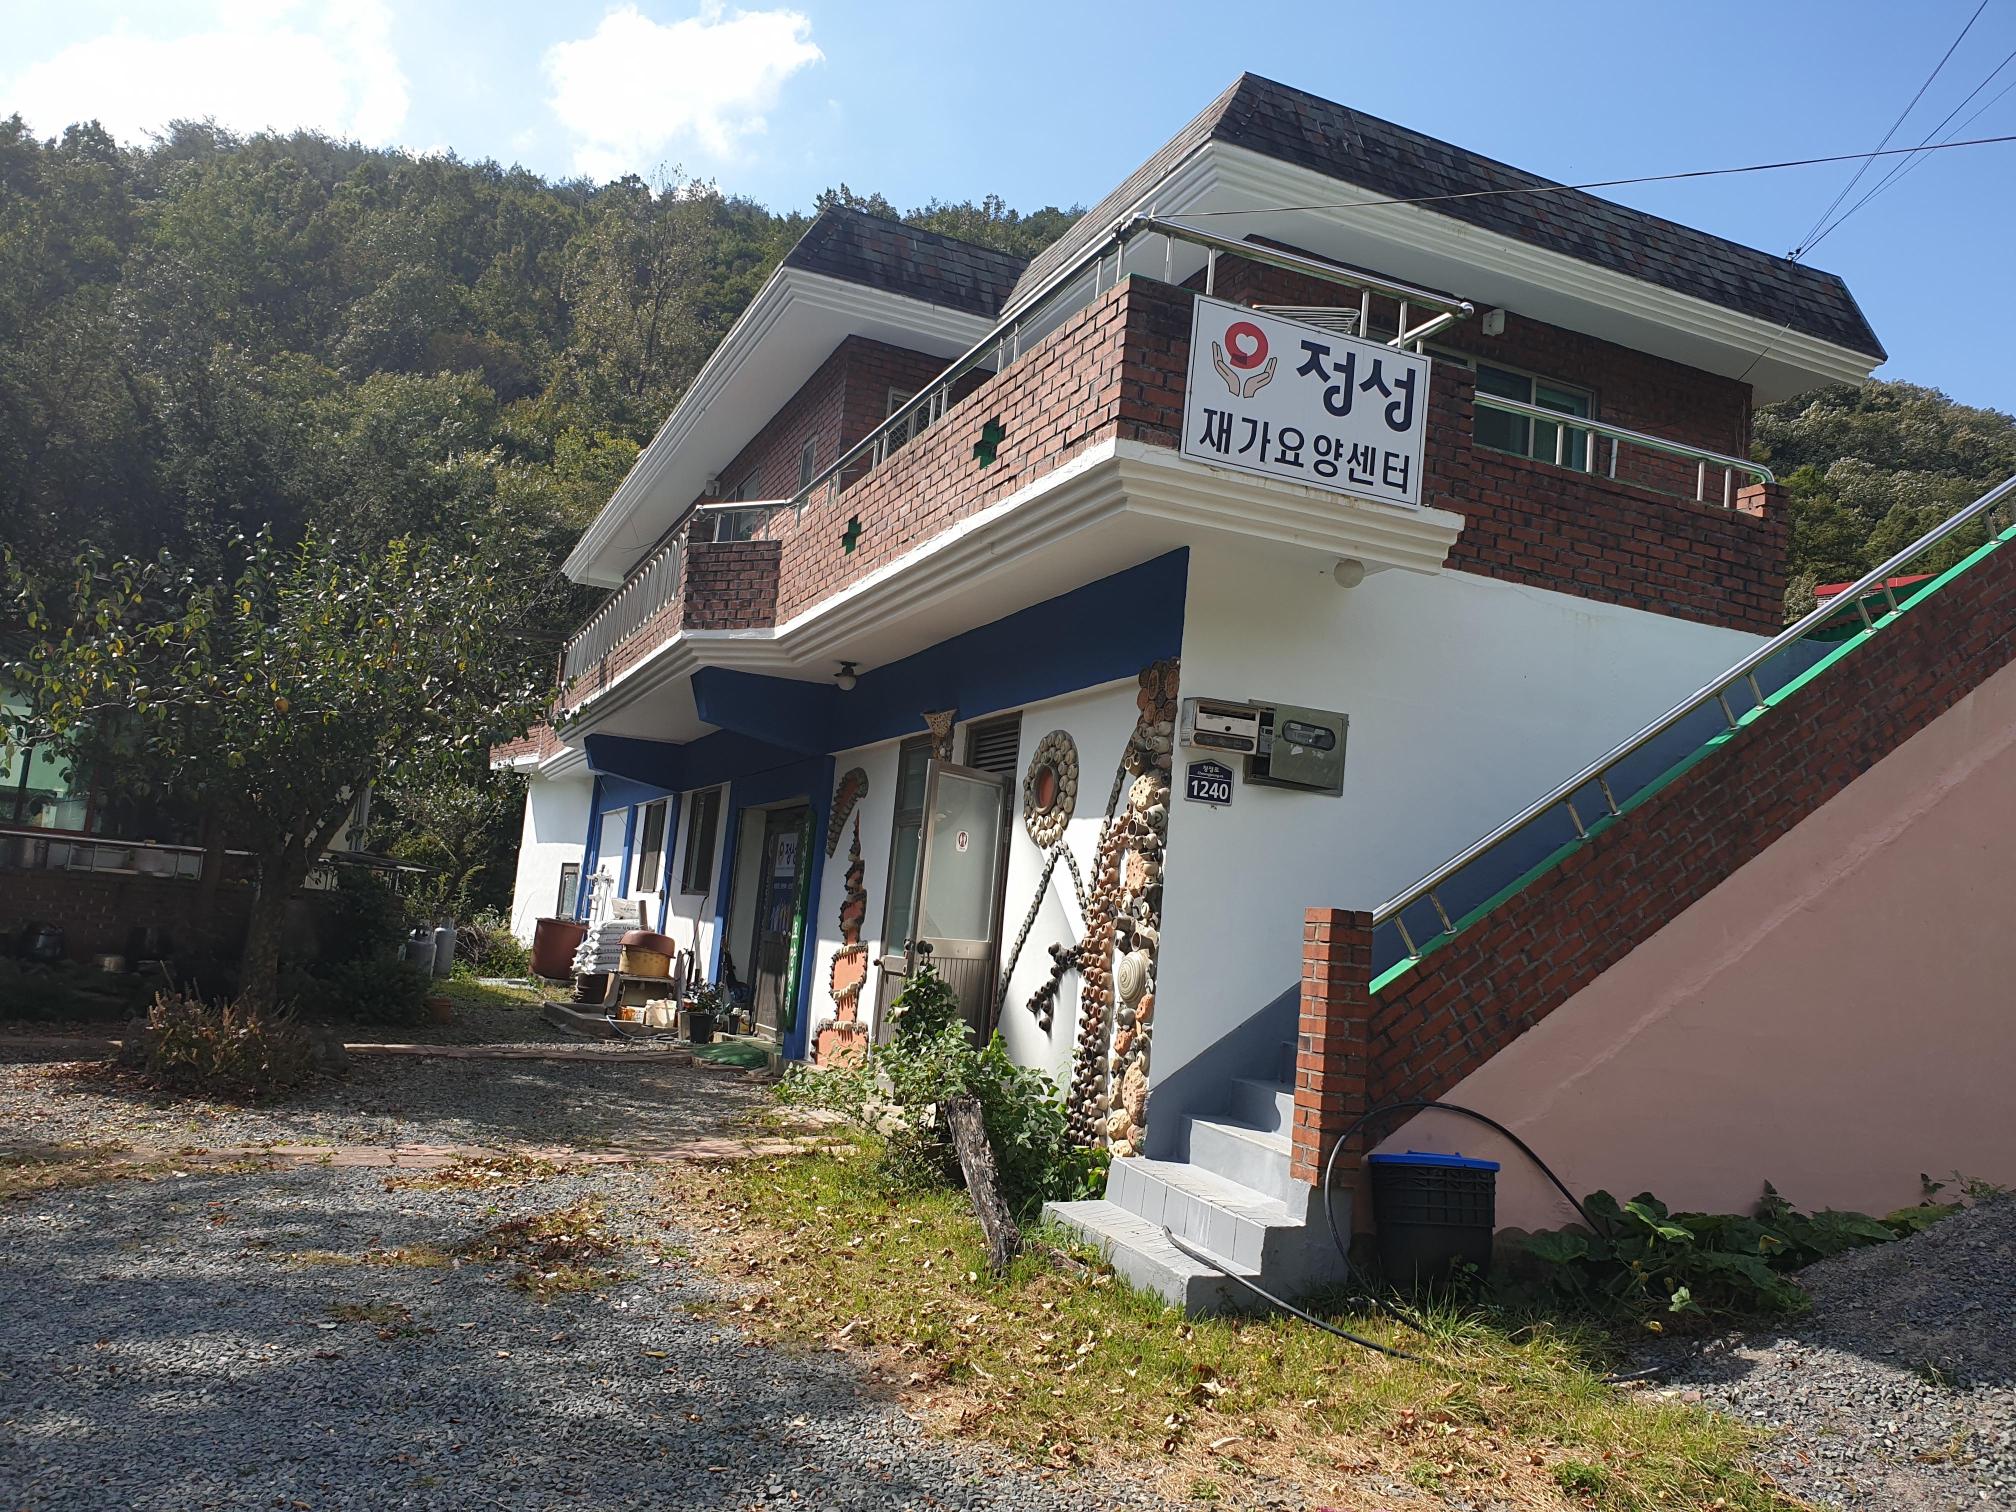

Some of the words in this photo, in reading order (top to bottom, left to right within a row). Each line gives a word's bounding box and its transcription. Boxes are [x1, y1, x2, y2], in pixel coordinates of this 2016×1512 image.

[1296, 340, 1417, 433] 정성
[1199, 408, 1410, 495] 재가요양센터
[1191, 780, 1229, 800] 1240
